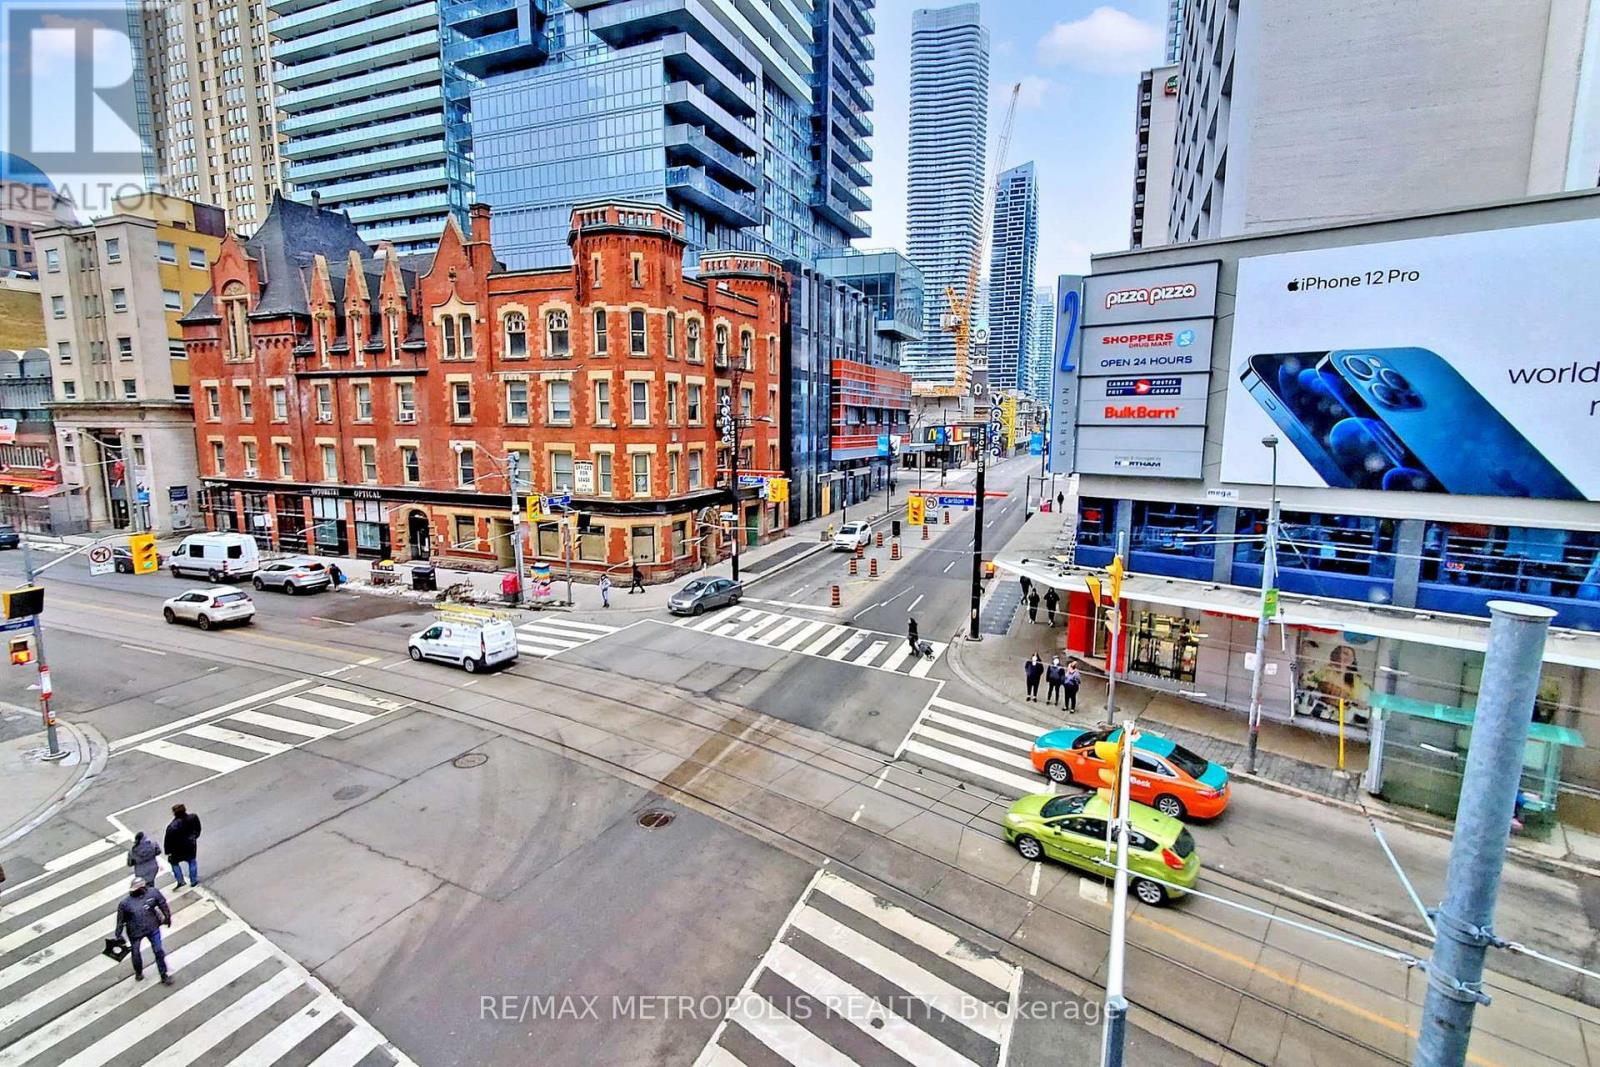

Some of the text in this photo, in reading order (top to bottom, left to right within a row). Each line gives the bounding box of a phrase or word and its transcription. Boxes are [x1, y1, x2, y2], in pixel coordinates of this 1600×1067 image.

[1301, 269, 1420, 291] iPhone 12 Pro
[1105, 284, 1196, 309] pizza pizza
[1060, 291, 1079, 372] 2
[1102, 333, 1174, 345] SHOPPERS
[1100, 355, 1193, 368] OPEN 24 HOURS
[353, 490, 381, 499] OPTICAL
